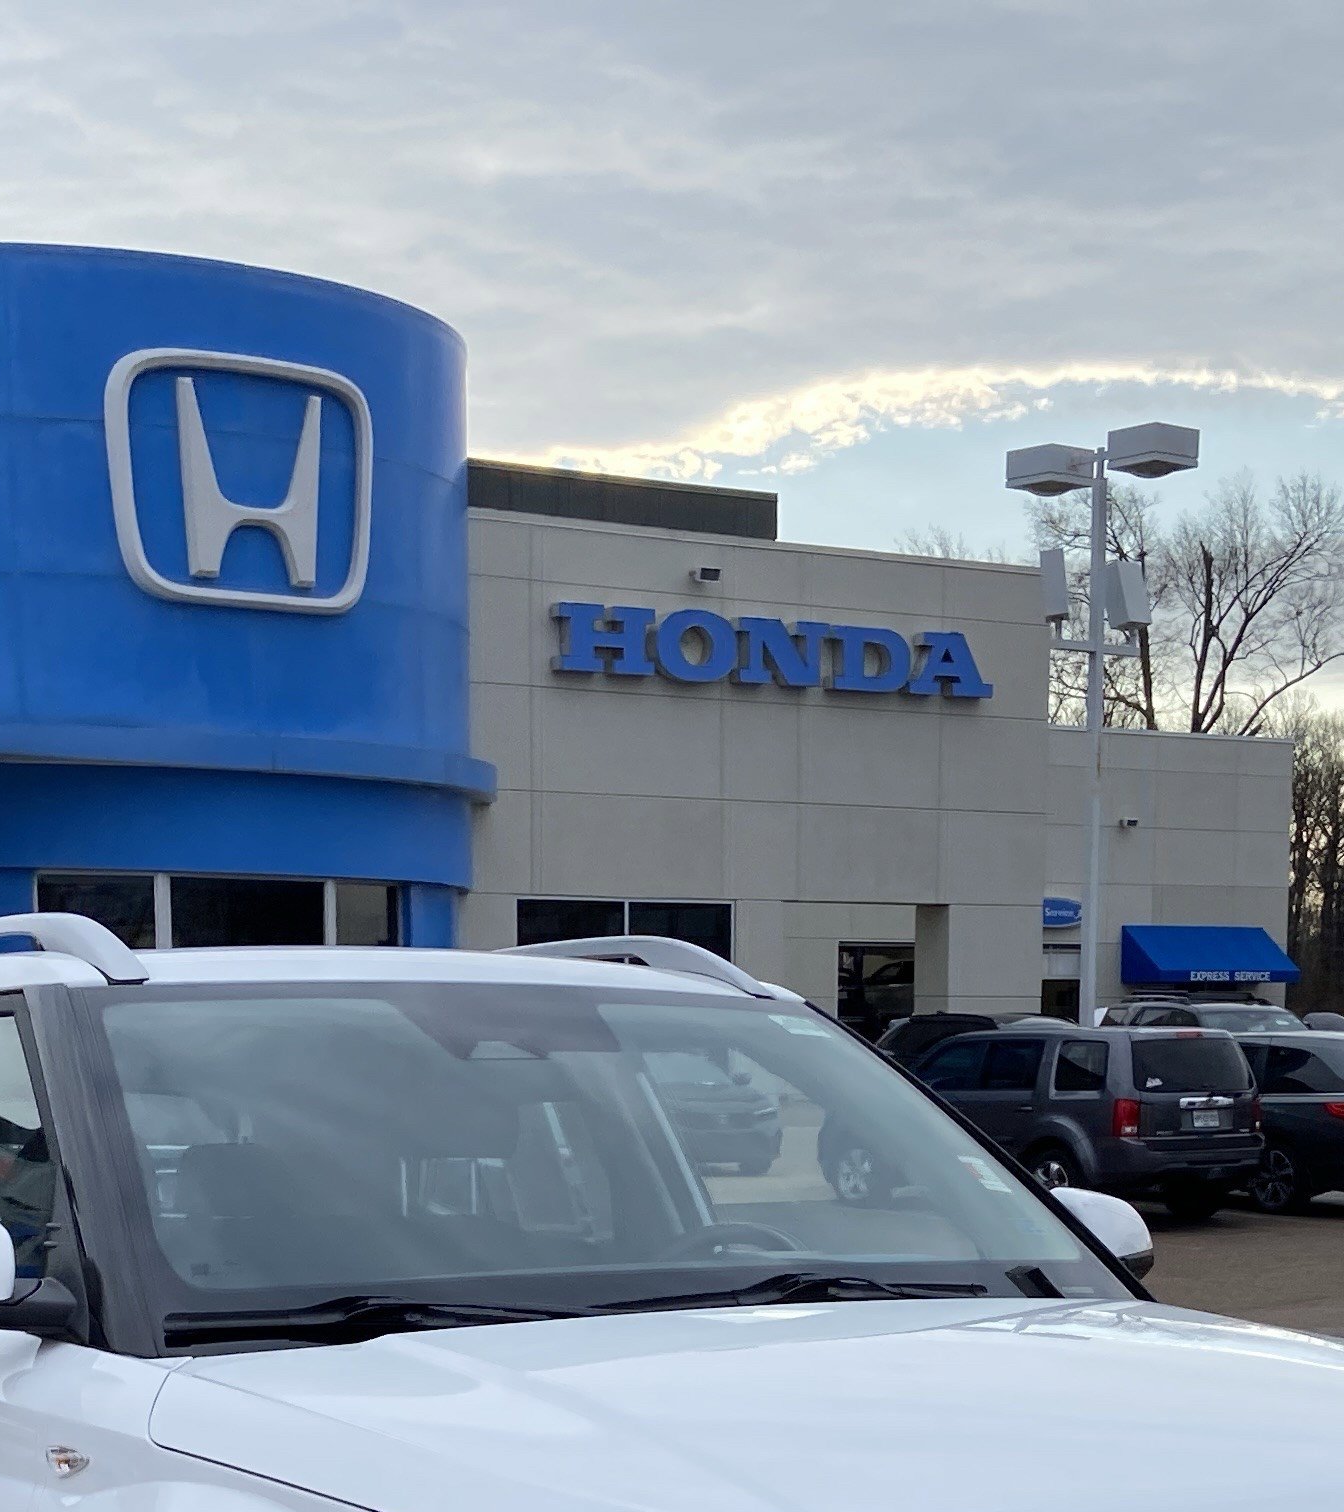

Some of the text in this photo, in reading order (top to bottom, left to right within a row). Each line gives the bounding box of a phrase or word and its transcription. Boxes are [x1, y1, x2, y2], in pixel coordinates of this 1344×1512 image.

[553, 602, 993, 699] HONDA
[1190, 971, 1271, 981] EXPRESS SERVICE
